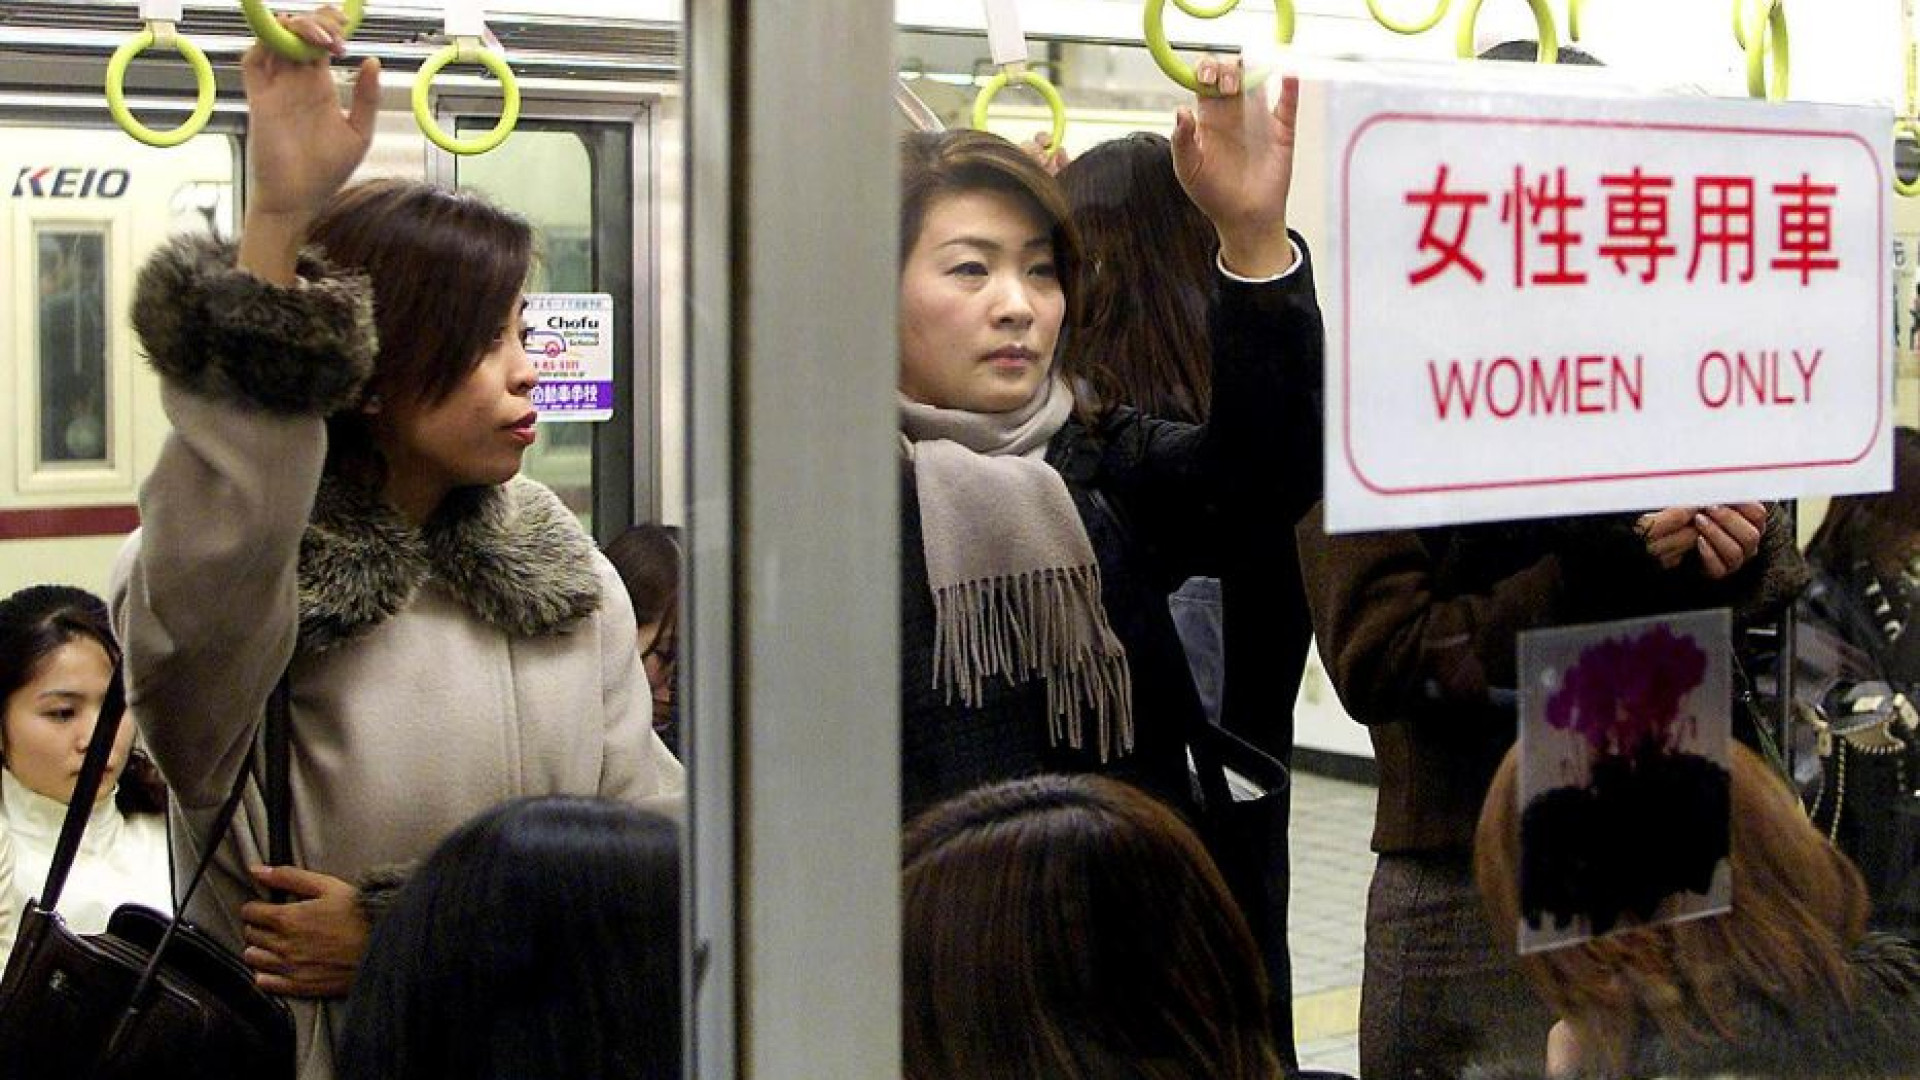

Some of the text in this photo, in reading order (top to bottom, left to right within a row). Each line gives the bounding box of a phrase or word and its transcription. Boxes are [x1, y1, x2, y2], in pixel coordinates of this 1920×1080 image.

[12, 167, 131, 199] KEIO
[1404, 164, 1841, 288] 女性専用車
[547, 316, 599, 329] Chofu
[1429, 350, 1823, 420] WOMEN ONLY
